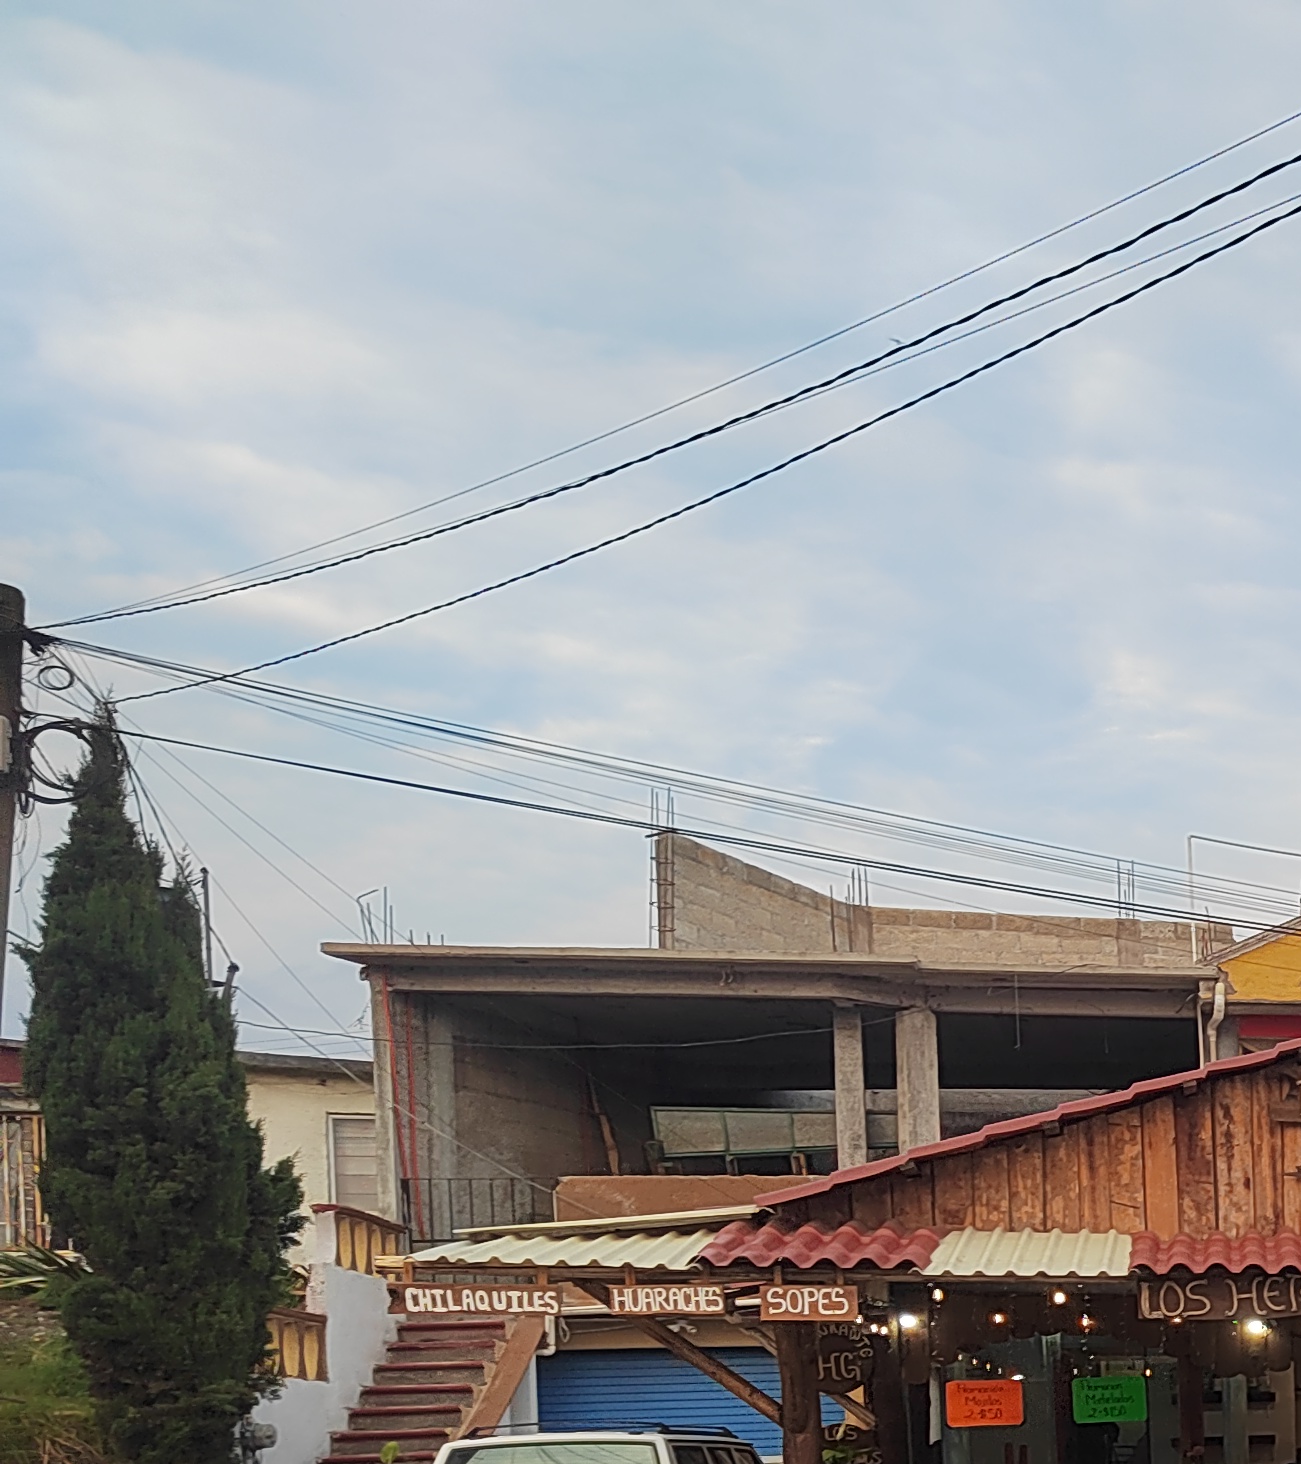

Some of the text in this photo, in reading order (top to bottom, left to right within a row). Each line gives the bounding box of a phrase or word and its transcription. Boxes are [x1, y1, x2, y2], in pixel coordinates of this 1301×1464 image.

[405, 1287, 560, 1313] CHILAQUILES
[612, 1286, 723, 1313] HUARACHES
[766, 1286, 850, 1315] SOPES
[1141, 1279, 1211, 1318] LOS
